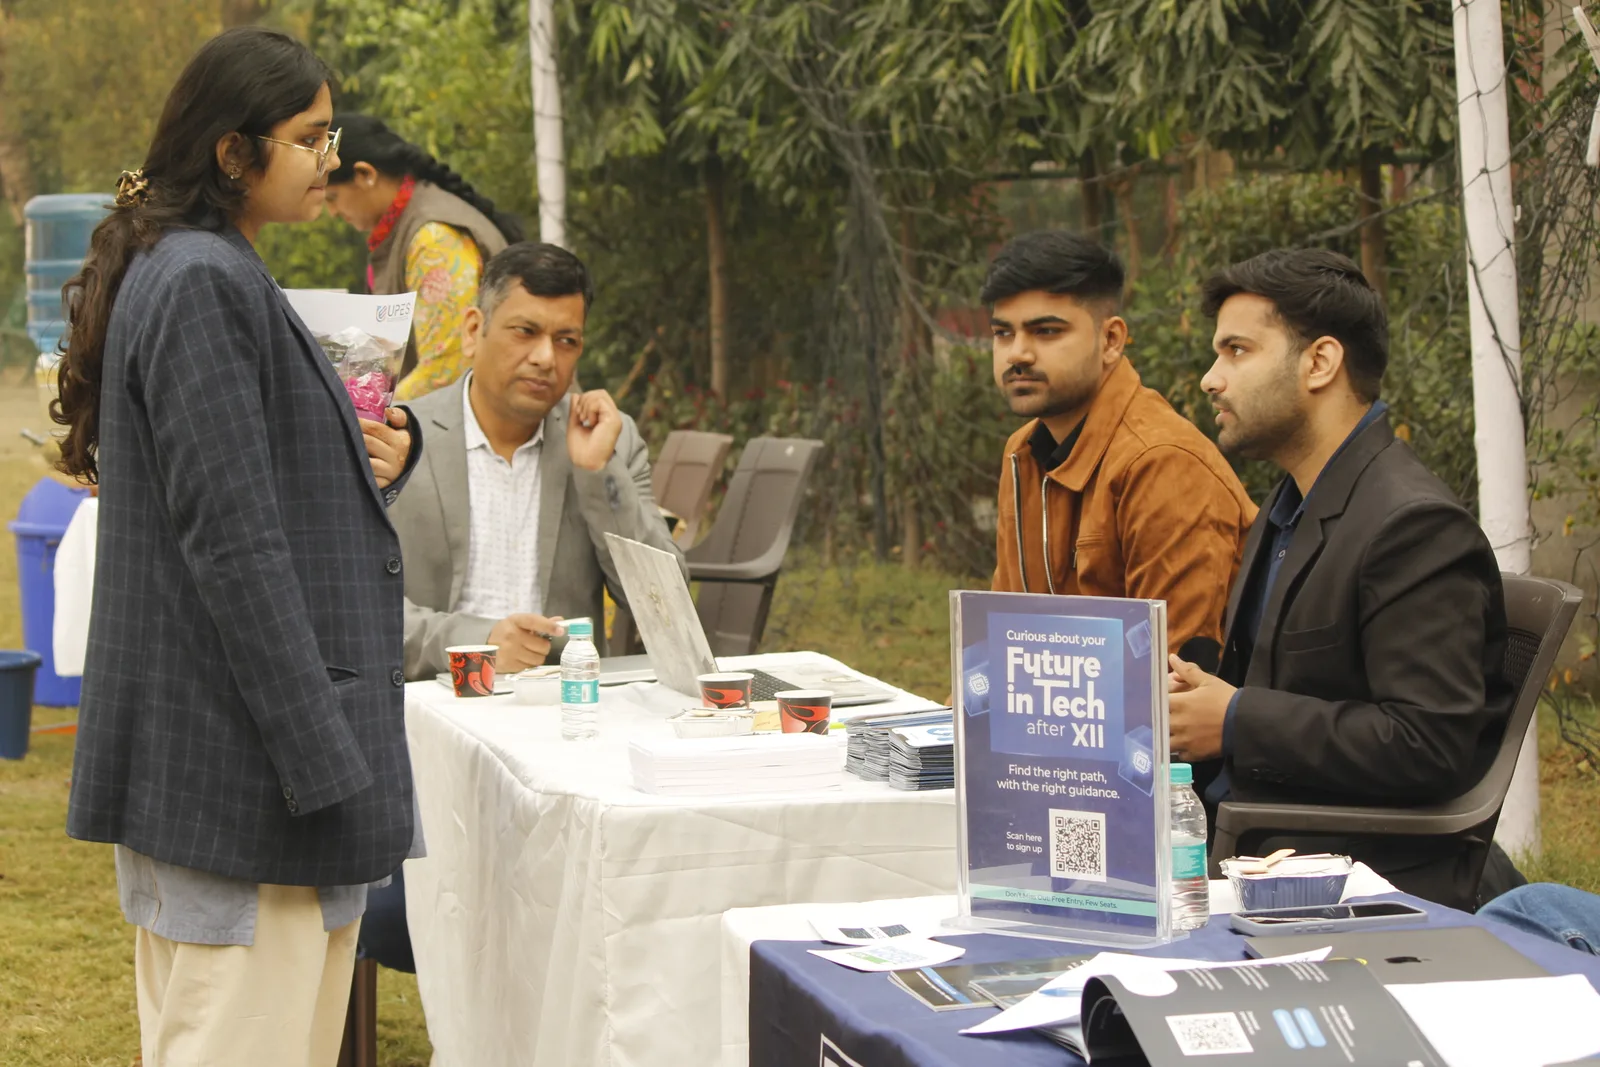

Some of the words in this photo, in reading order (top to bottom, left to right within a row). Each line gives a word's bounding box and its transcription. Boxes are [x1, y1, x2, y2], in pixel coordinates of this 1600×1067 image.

[387, 302, 410, 317] UPES
[1006, 629, 1047, 642] Curious
[1048, 631, 1080, 645] about
[1081, 635, 1106, 647] your
[1006, 646, 1101, 689] Future
[1007, 683, 1034, 715] in
[1032, 678, 1106, 721] Tech
[1026, 719, 1066, 737] after
[1071, 722, 1105, 749] XII
[1008, 763, 1031, 777] Find
[1033, 766, 1051, 778] the
[1053, 767, 1079, 781] right
[1080, 770, 1108, 784] path,
[997, 778, 1020, 791] with
[1022, 779, 1040, 792] the
[1041, 781, 1067, 796] right
[1068, 784, 1120, 800] guidance.
[1006, 831, 1025, 841] Scan
[1025, 832, 1043, 843] here
[1006, 842, 1015, 851] to
[1015, 842, 1032, 853] sign
[1032, 845, 1043, 855] up
[1051, 895, 1065, 904] Free
[1085, 899, 1098, 907] Few
